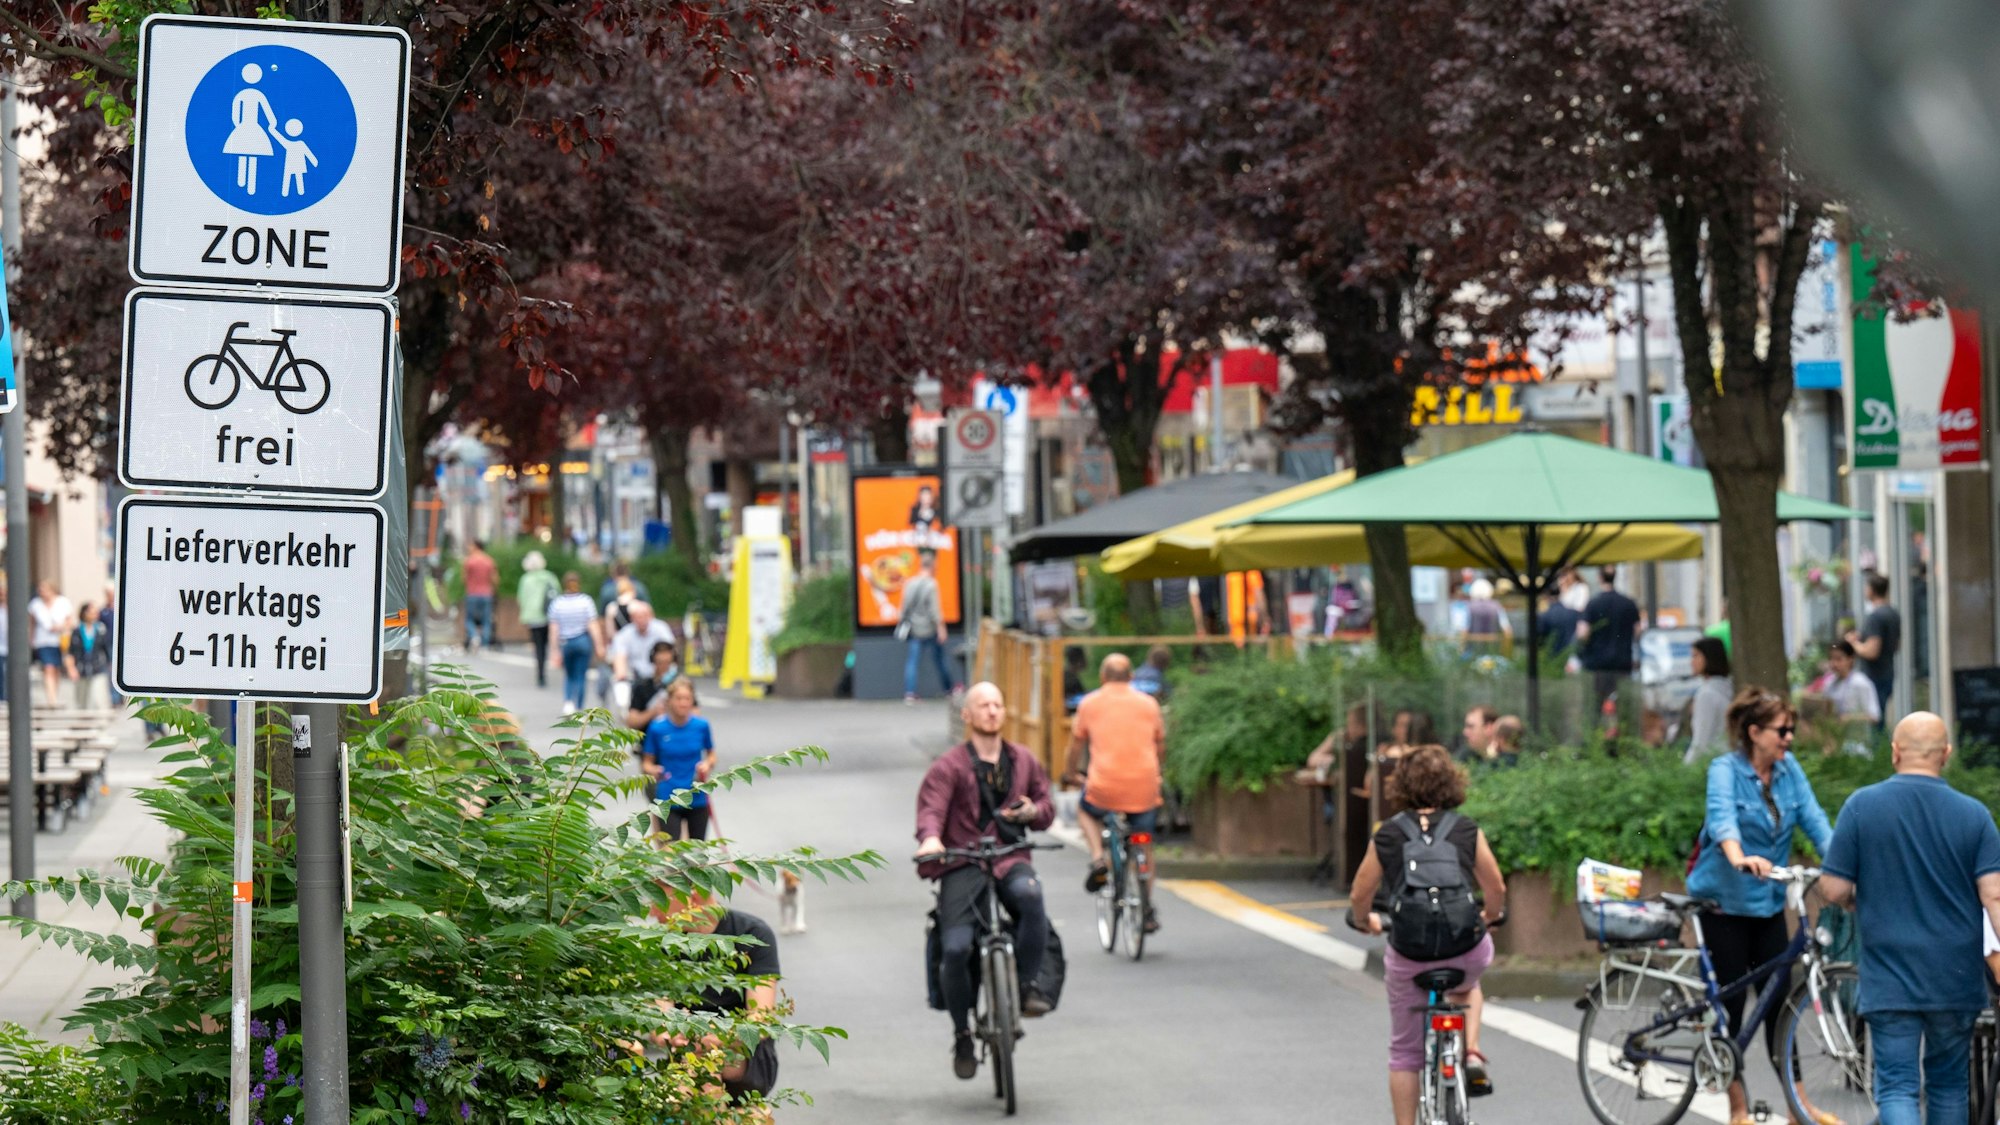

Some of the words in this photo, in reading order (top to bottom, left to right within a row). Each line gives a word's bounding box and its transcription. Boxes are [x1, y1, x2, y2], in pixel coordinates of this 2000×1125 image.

[201, 224, 330, 270] ZONE
[216, 424, 294, 466] frei
[147, 526, 356, 568] Lieferverkehr
[179, 582, 321, 628] werktags
[169, 631, 257, 669] 6-11h
[274, 635, 327, 671] frei
